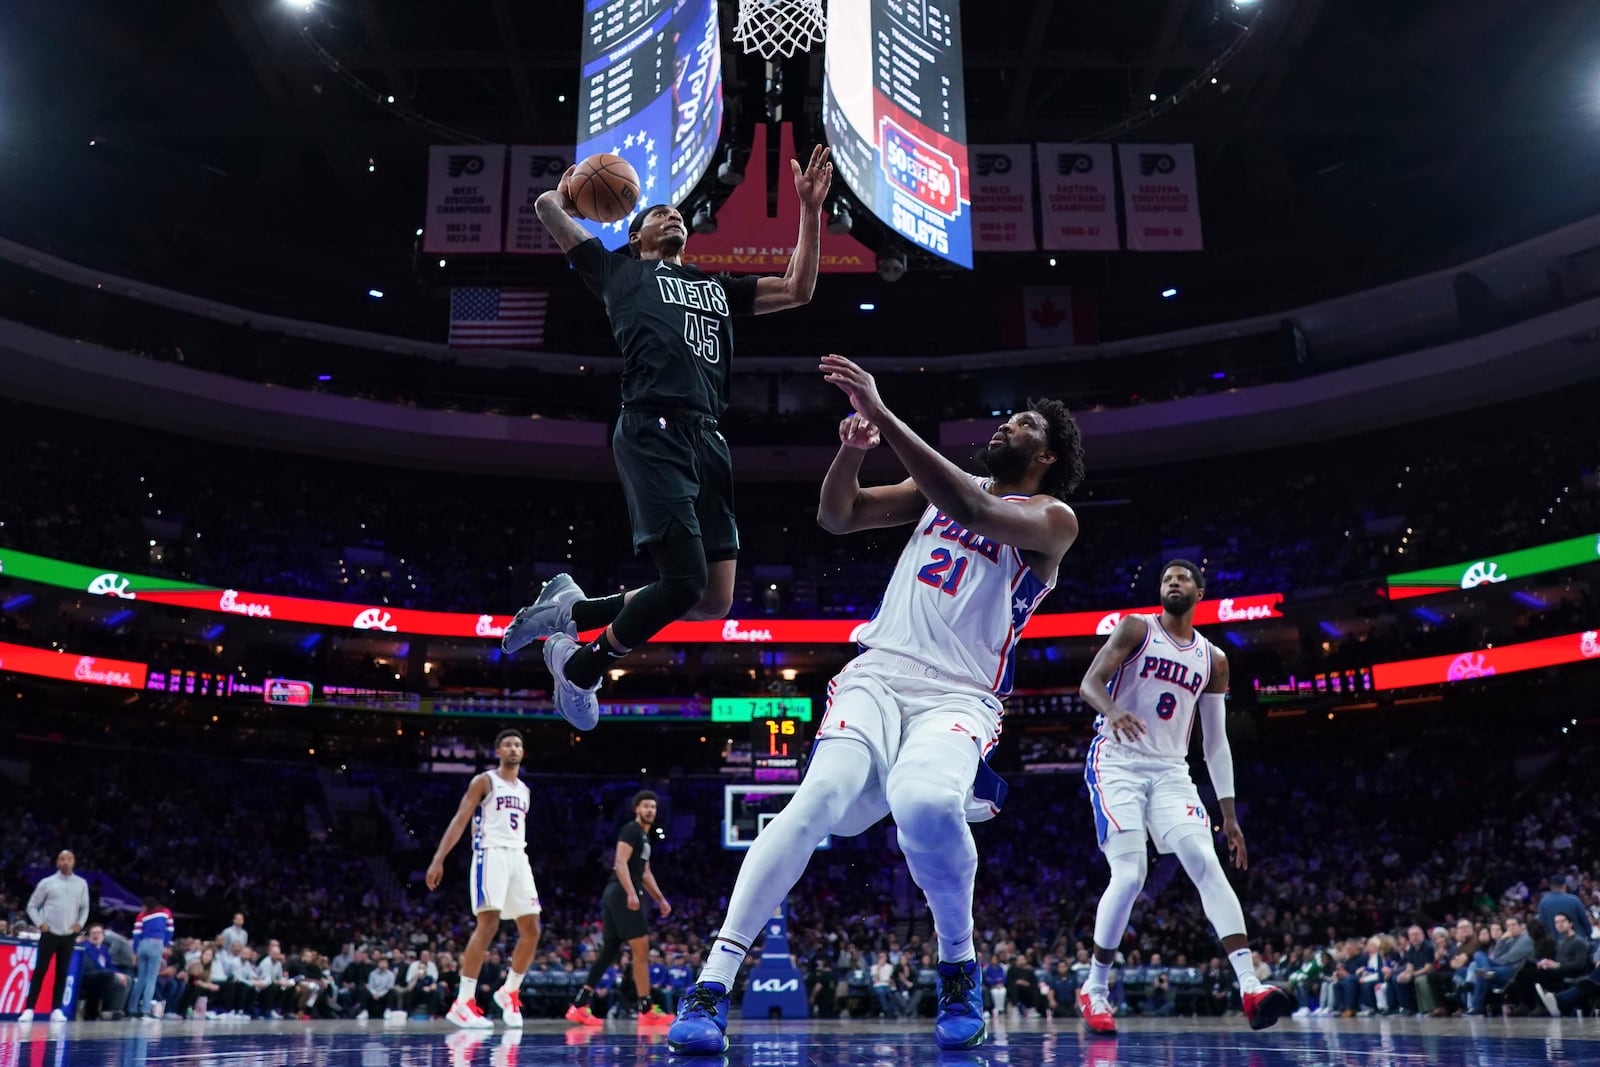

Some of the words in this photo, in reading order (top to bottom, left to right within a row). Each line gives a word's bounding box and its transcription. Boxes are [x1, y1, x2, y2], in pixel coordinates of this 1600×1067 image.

[928, 168, 950, 197] 50
[892, 203, 949, 254] $10,675
[732, 246, 796, 256] ENTER
[656, 275, 730, 317] NETS
[684, 311, 720, 364] 45
[917, 548, 968, 596] 21
[1156, 692, 1177, 720] 8
[510, 813, 519, 830] 5
[1186, 805, 1205, 819] 76
